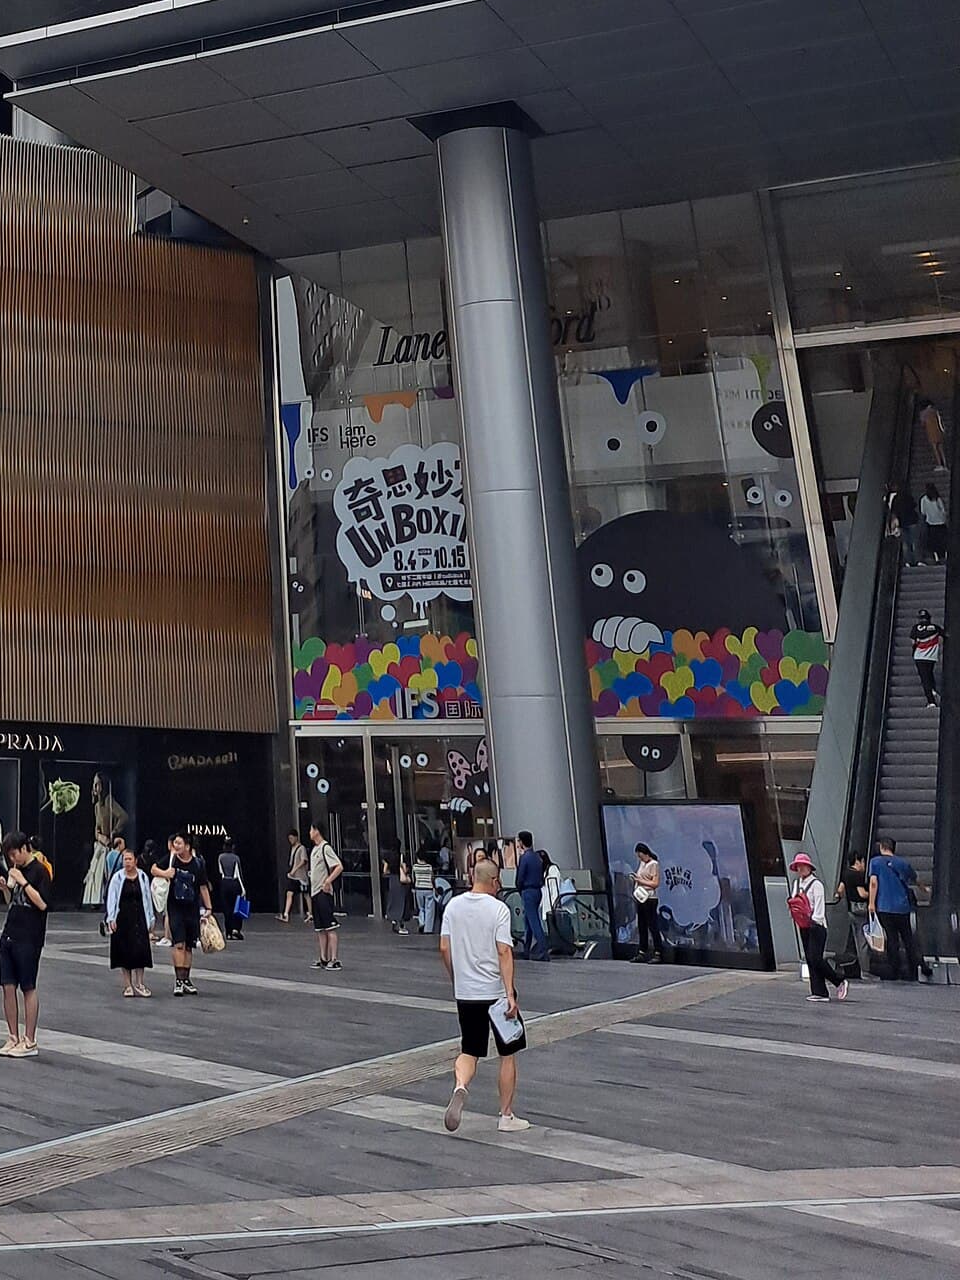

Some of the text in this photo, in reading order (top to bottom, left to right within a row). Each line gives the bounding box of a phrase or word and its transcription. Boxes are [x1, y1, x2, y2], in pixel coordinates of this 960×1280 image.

[373, 325, 448, 367] Lane
[307, 426, 329, 443] IFS
[345, 425, 366, 437] am
[340, 434, 377, 449] Here
[393, 545, 466, 571] 8.4 10.15
[395, 687, 440, 719] IFS
[187, 823, 227, 836] PRADA
